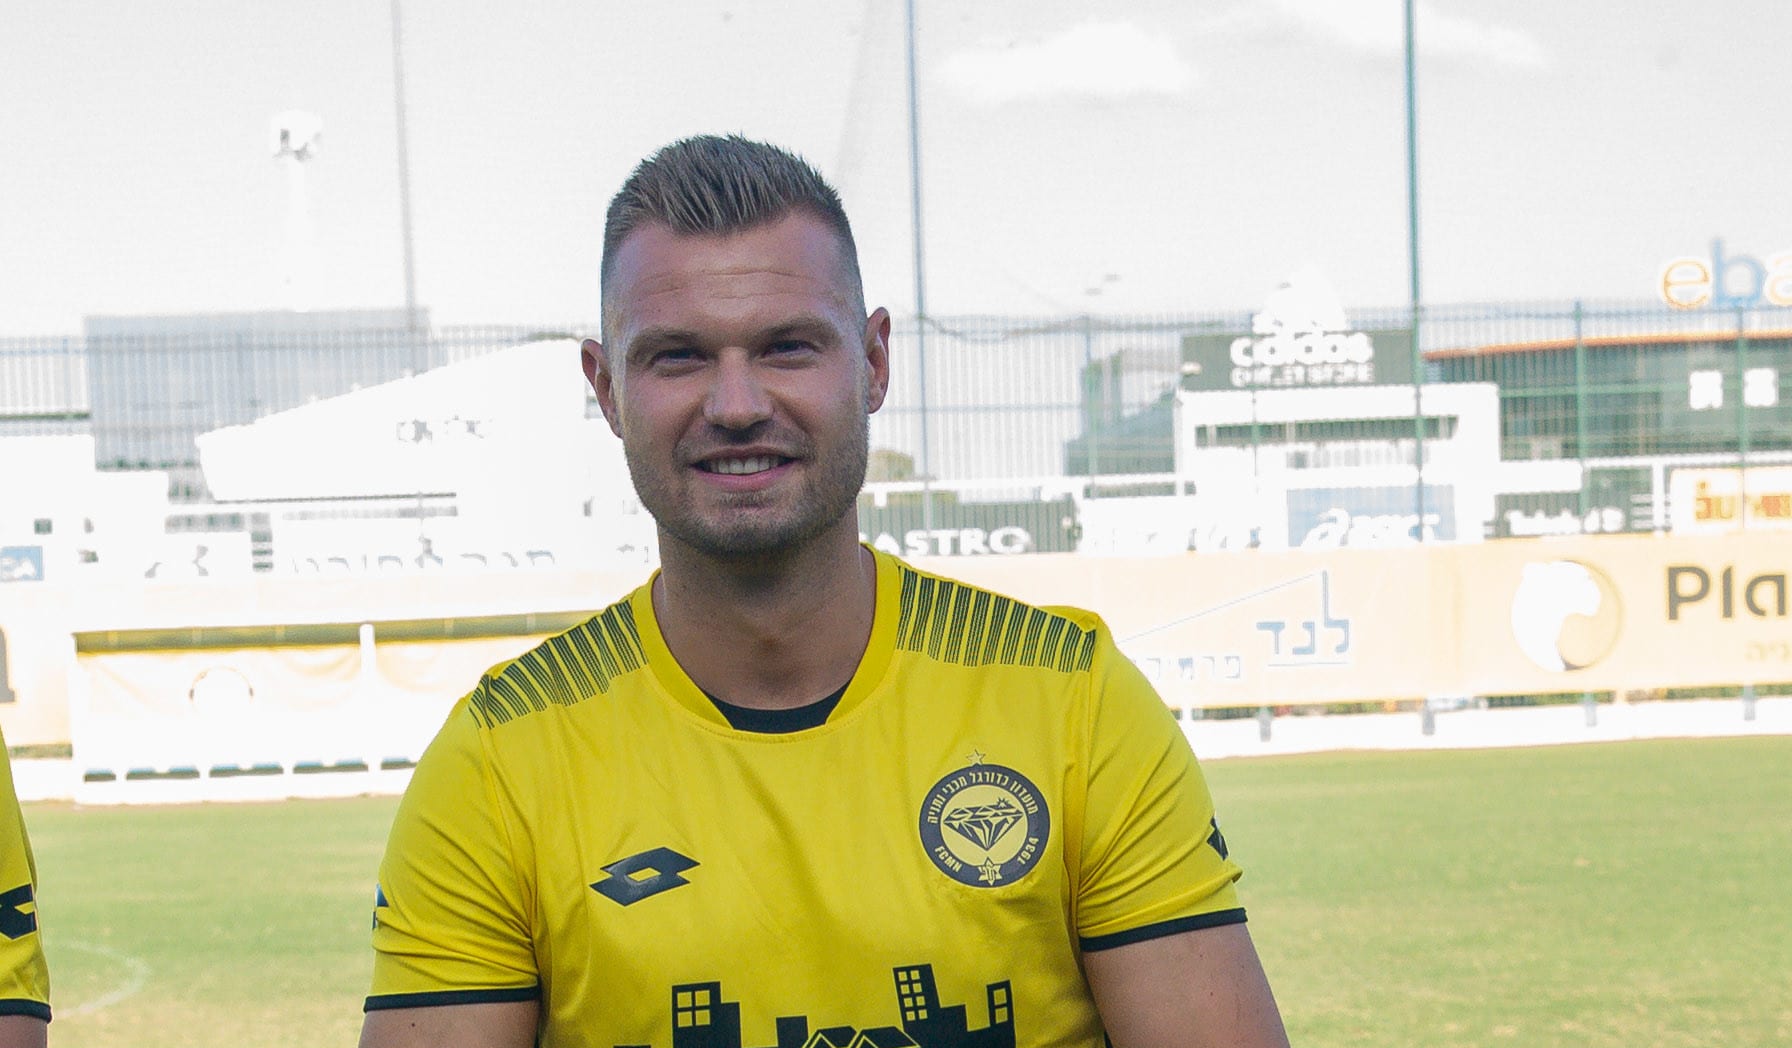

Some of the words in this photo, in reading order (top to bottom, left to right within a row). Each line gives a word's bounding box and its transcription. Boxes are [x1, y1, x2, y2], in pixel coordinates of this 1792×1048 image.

[860, 527, 1031, 555] ASTRO
[1667, 565, 1787, 621] Pla
[1256, 569, 1350, 655] לנד
[942, 776, 968, 794] מכבי
[969, 771, 1010, 785] כדורגל
[927, 793, 946, 824] נתניה
[1010, 780, 1039, 815] מועדון
[934, 845, 963, 872] FCMN
[1017, 836, 1039, 865] 1934
